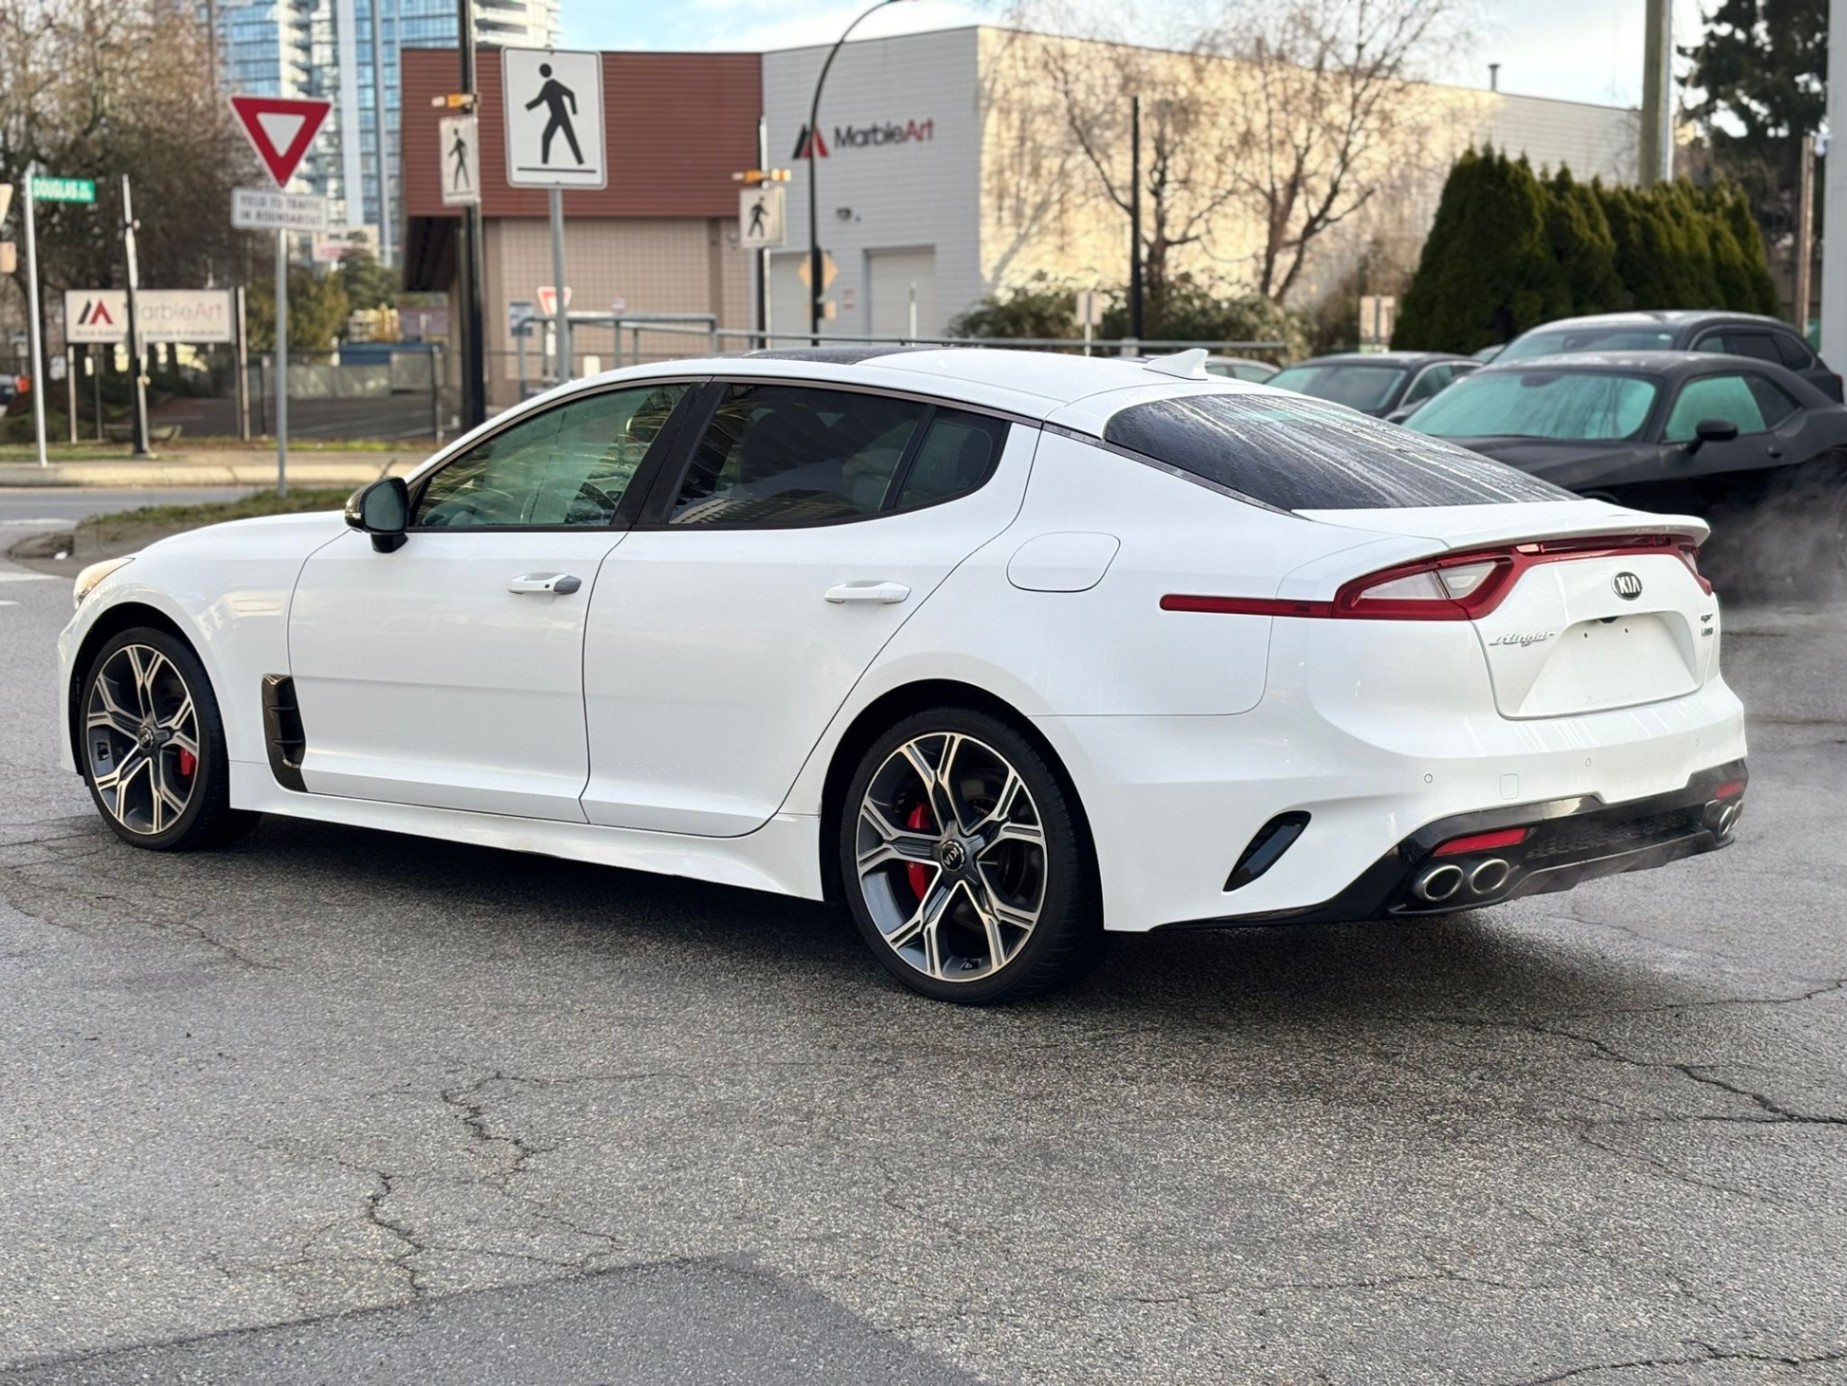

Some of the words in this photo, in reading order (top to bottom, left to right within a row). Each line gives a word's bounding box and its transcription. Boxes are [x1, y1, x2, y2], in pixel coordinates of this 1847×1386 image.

[834, 117, 934, 148] MarbleArt
[124, 302, 222, 321] arbleArt
[1616, 575, 1640, 594] KIA
[943, 847, 960, 866] KIA
